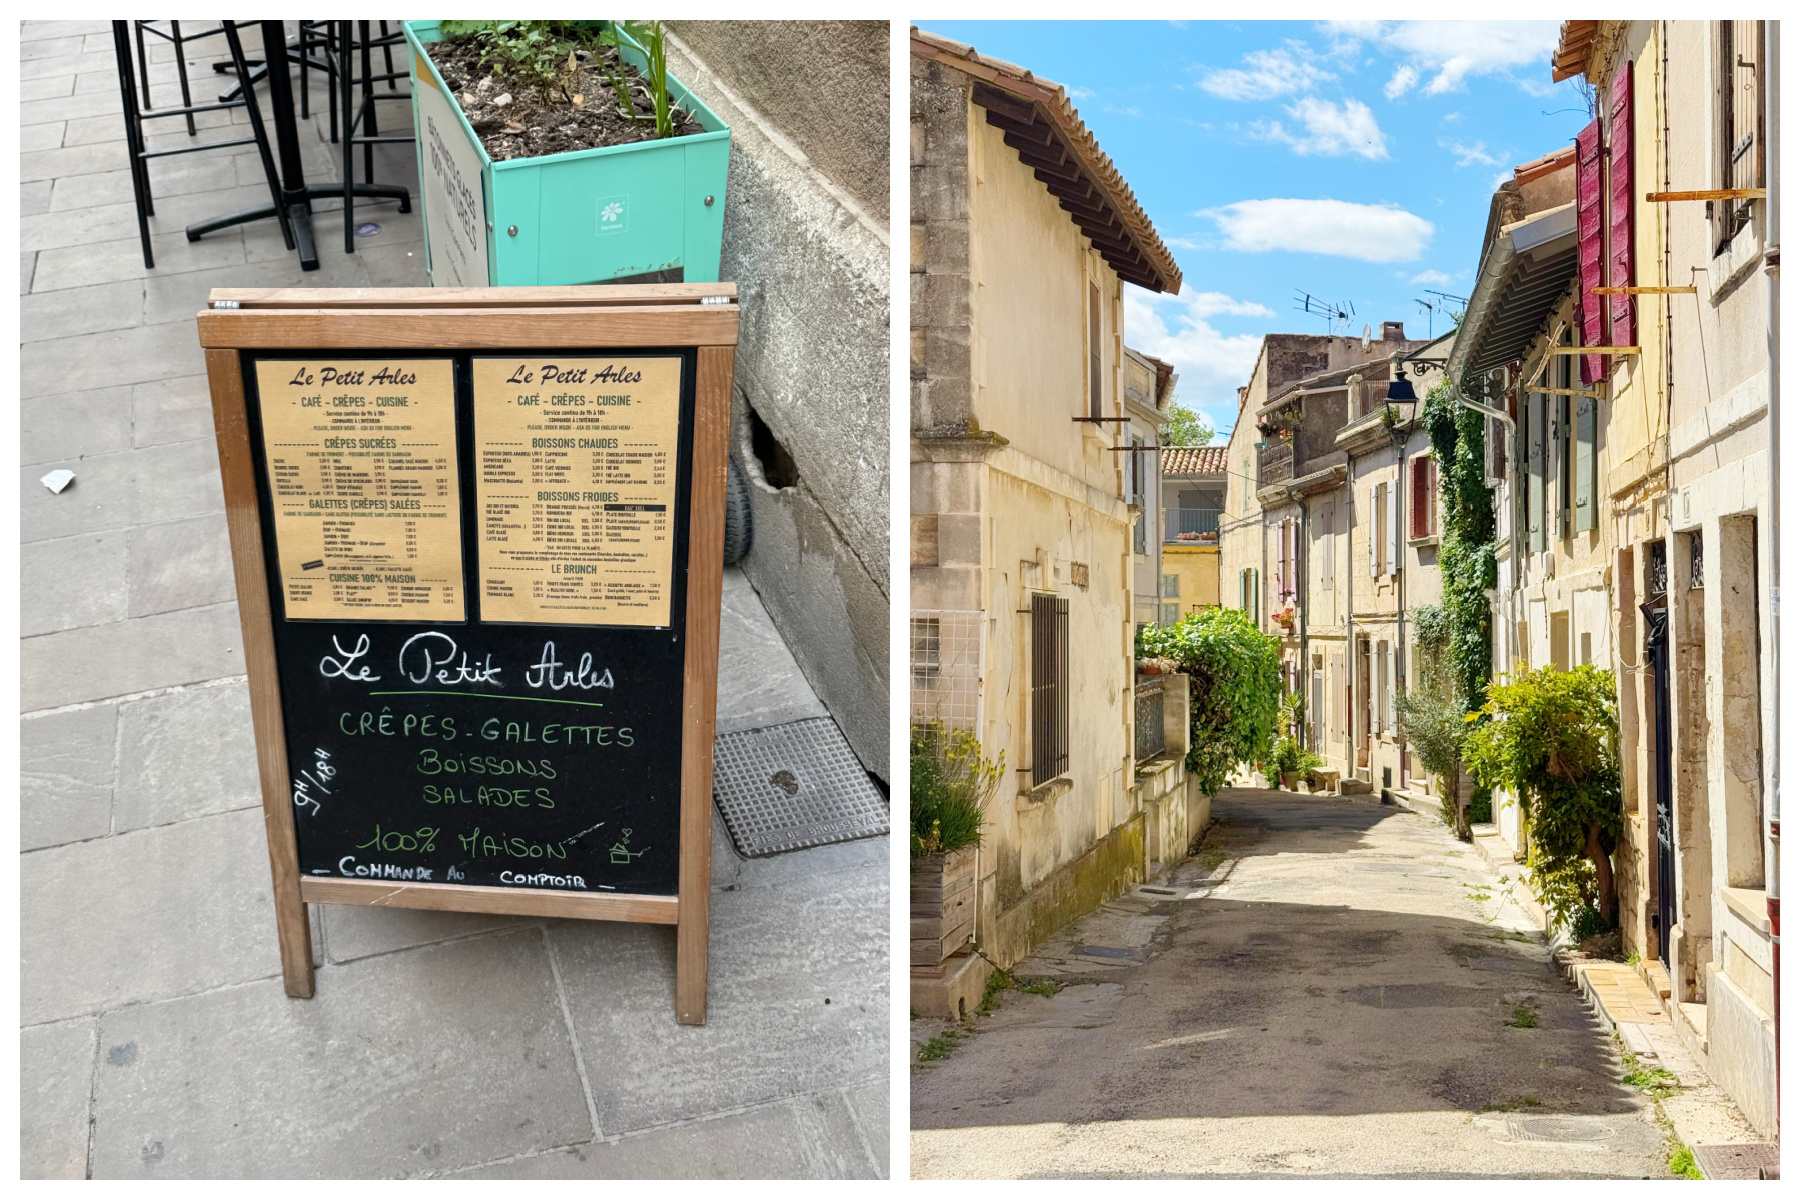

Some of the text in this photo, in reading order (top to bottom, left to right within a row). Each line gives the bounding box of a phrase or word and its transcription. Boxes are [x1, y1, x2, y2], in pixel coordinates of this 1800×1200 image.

[288, 366, 417, 387] Le Petit Arles
[506, 364, 642, 385] Le Petit Arles
[301, 394, 409, 407] CAFÉ CRÊPES CUISINE
[517, 392, 631, 406] CAFÉ CRÊPES CUISINE
[324, 436, 396, 448] CRÊPES SUCRÉES
[532, 438, 618, 448] BOISSONS CHAUDES
[309, 497, 420, 511] GALETTES (CRÊPES) SALÉES
[538, 492, 619, 502] BOISSONS FROIDES
[552, 564, 597, 574] LE BRUNCH
[329, 574, 416, 583] CUISINE 100% MAISON
[319, 631, 615, 690] Le Petit Arles
[340, 706, 635, 748] CRÊPES GALETTES
[422, 785, 555, 809] SALADES
[785, 829, 800, 840] DE
[806, 815, 881, 837] BROUSSEVAL
[356, 824, 441, 853] 100%
